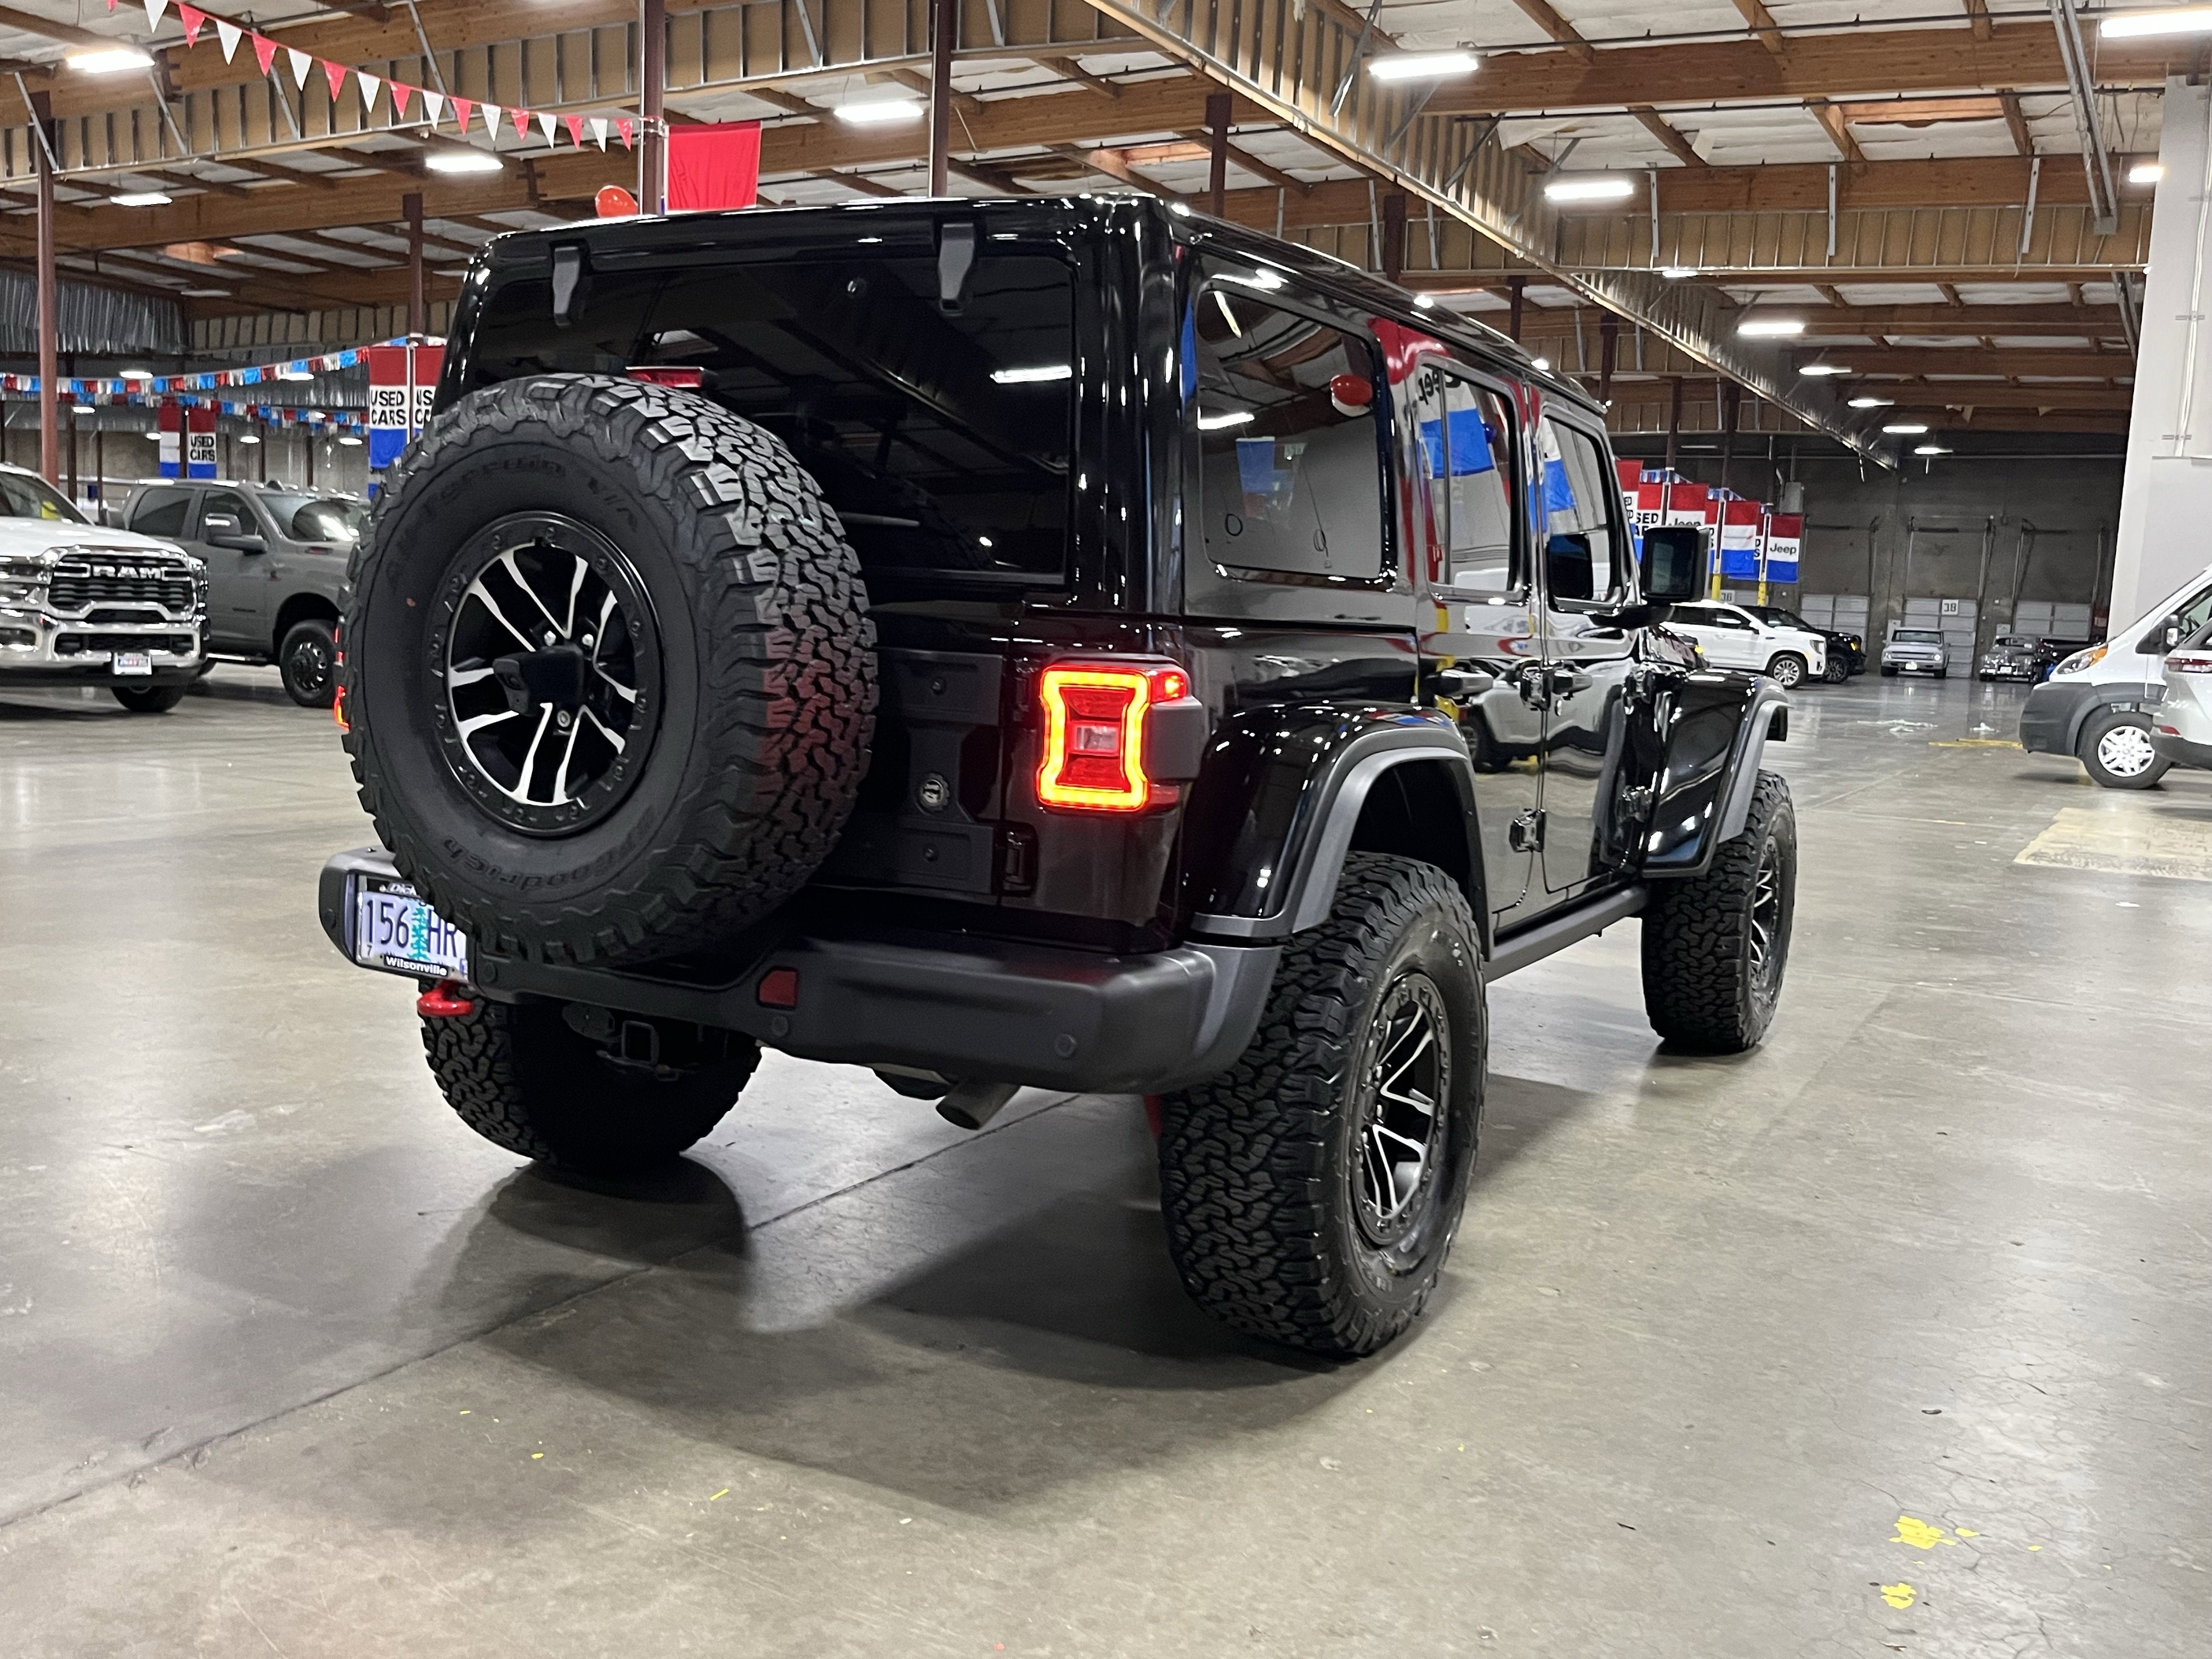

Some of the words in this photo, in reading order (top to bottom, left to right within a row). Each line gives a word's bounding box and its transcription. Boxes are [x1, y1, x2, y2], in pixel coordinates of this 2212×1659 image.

[371, 389, 405, 407] USED
[416, 389, 433, 406] US
[371, 409, 407, 425] CARS
[190, 435, 215, 448] USED
[1636, 512, 1659, 524] SED
[1770, 543, 1797, 555] Jeep
[92, 565, 161, 579] RAM
[1944, 602, 1957, 612] 38
[367, 900, 409, 949] 156
[386, 956, 448, 976] Wilsonville
